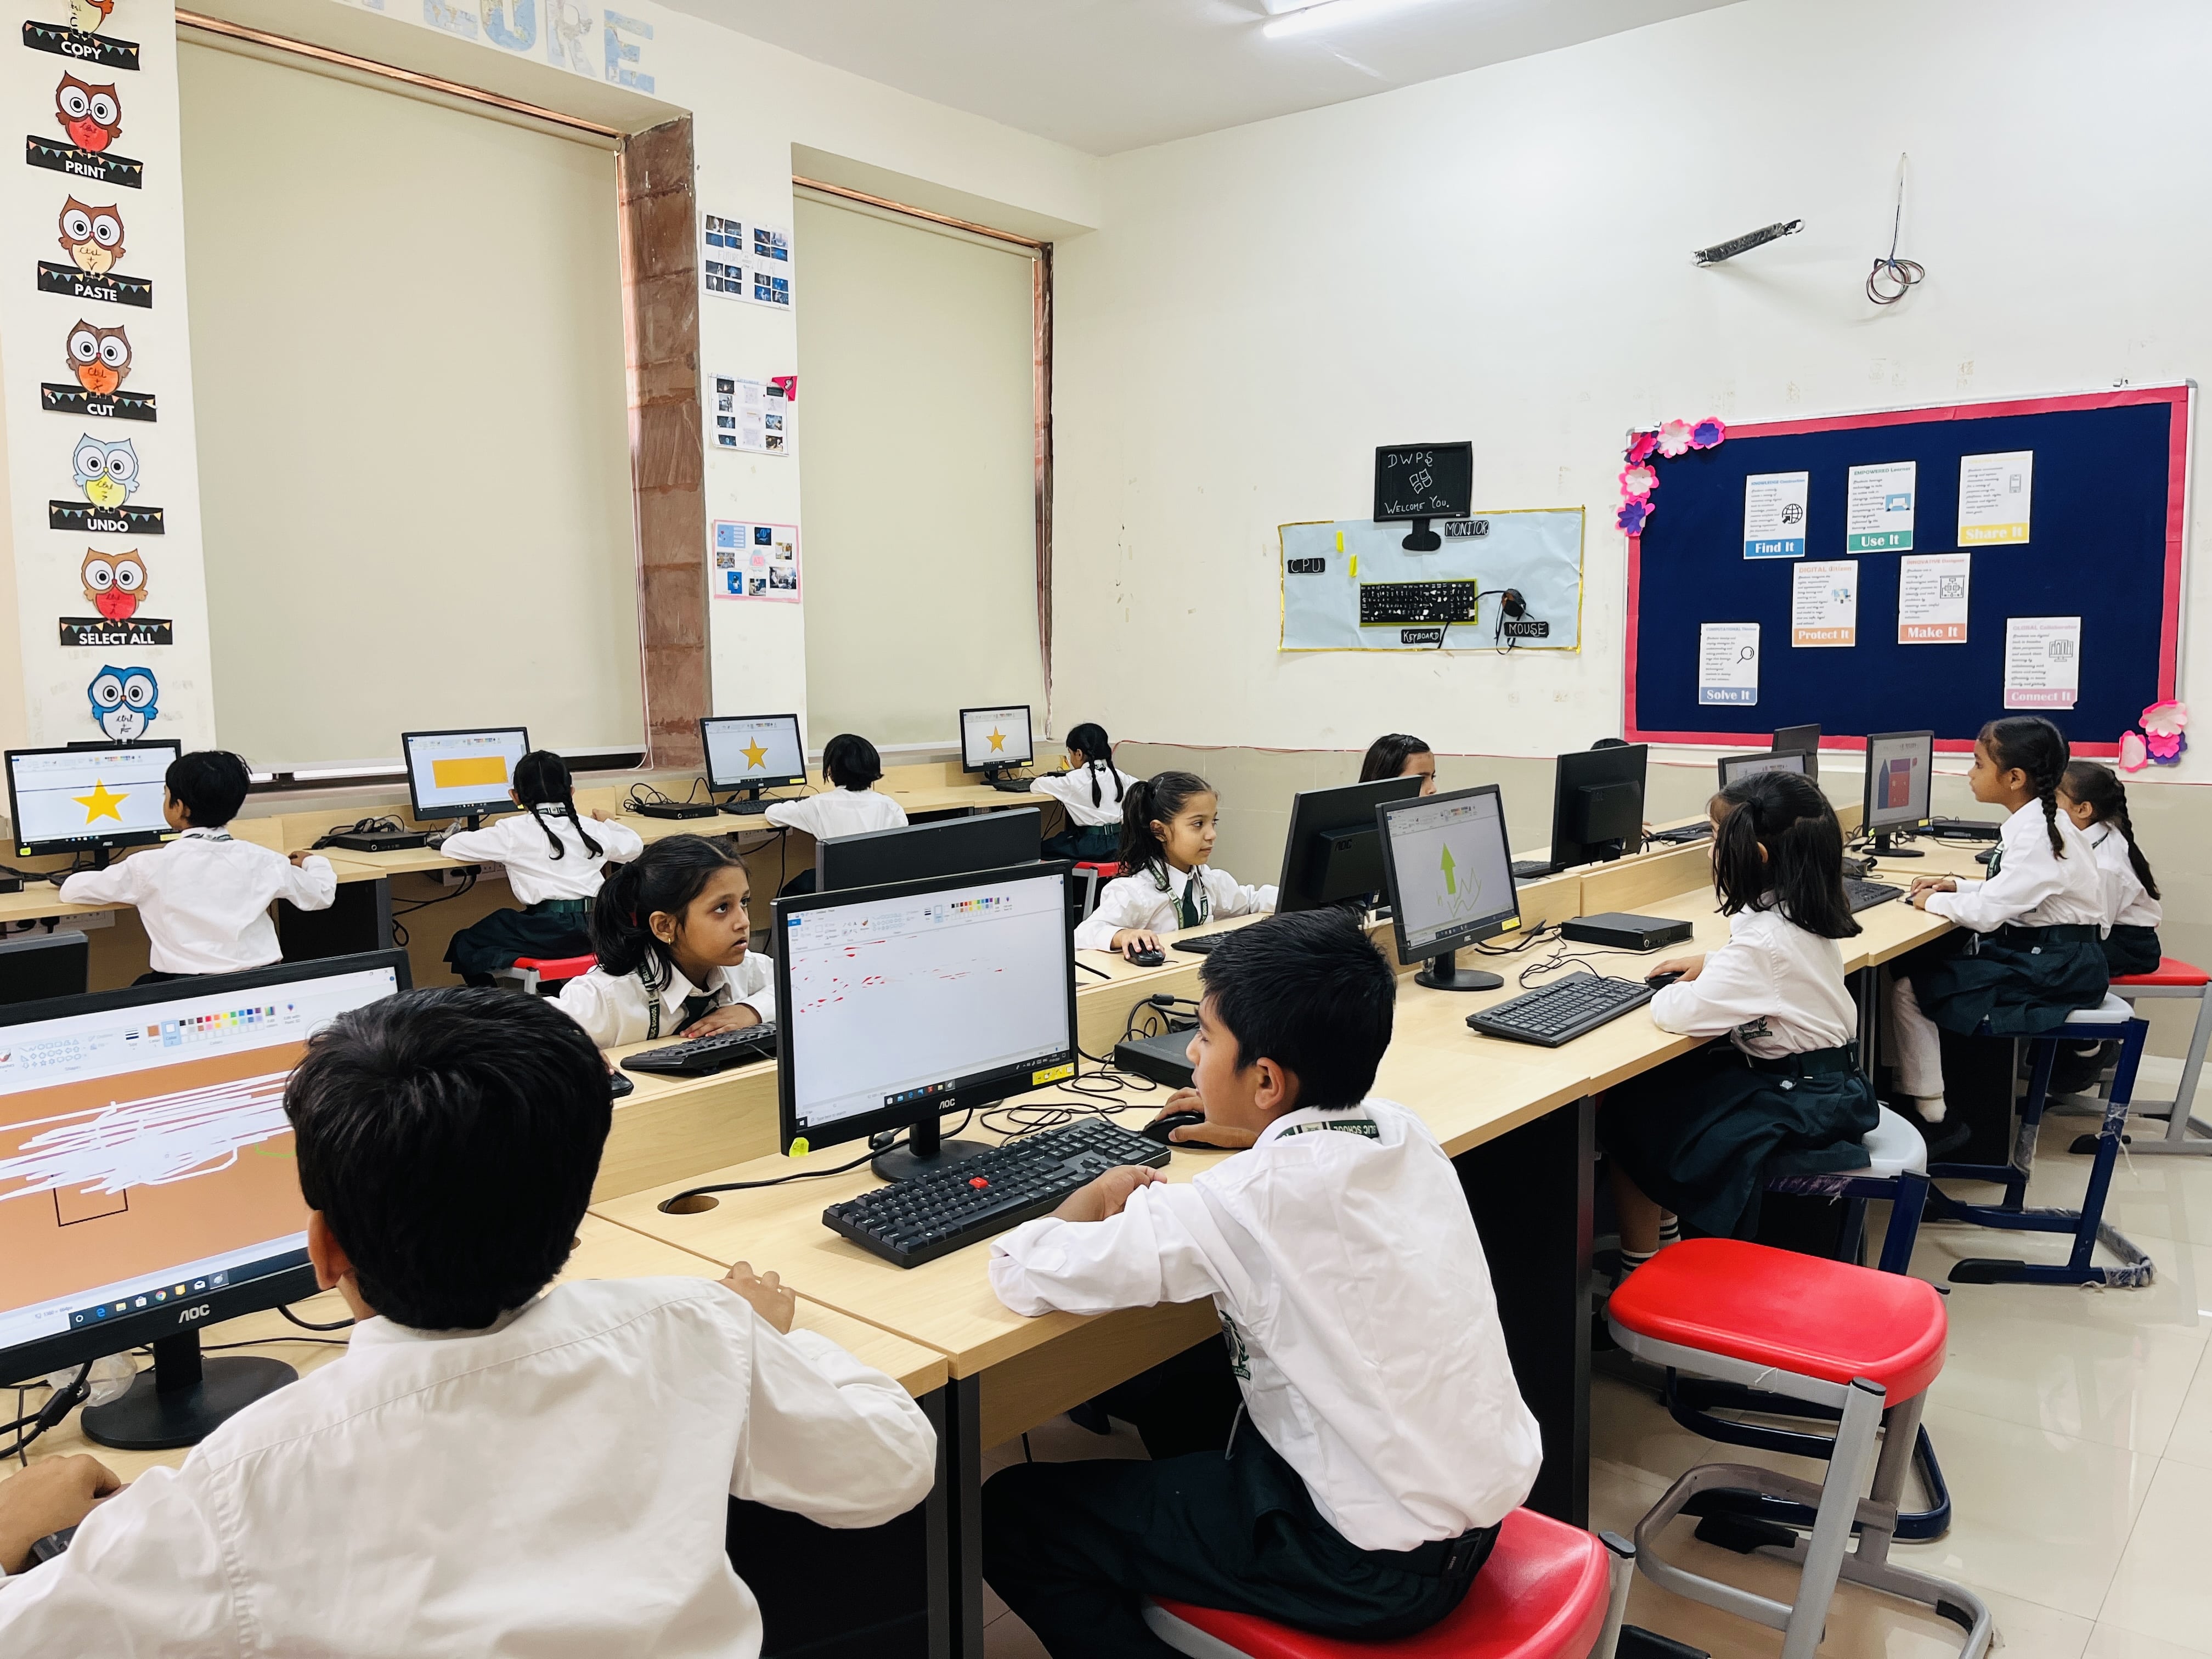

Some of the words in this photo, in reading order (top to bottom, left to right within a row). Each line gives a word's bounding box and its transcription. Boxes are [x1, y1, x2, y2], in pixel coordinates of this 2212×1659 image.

[61, 41, 102, 60] COPY
[65, 160, 106, 179] PRINT
[75, 283, 117, 301] PASTE
[87, 403, 115, 416] CUT
[1387, 451, 1434, 469] DWPS
[87, 518, 129, 532] UNDO
[1446, 521, 1489, 537] MONITOR
[1966, 527, 2007, 540] Share
[2012, 526, 2022, 538] It
[1755, 541, 1781, 554] Find
[1785, 541, 1795, 552] It
[1861, 535, 1885, 547] Use
[1889, 534, 1899, 545] It
[1289, 558, 1321, 573] CPU
[1509, 623, 1546, 637] MOUSE
[1798, 630, 1837, 640] Protect
[1841, 629, 1849, 639] It
[1908, 627, 1943, 638] Make
[1948, 627, 1958, 637] It
[79, 633, 127, 645] SELECT
[130, 633, 155, 644] ALL
[1403, 630, 1440, 645] KEYBOARD
[1707, 689, 1737, 700] Solve
[1741, 690, 1750, 700] It
[2011, 691, 2058, 701] Connect
[2062, 691, 2072, 701] It
[939, 1098, 956, 1110] AOC
[178, 1304, 210, 1324] AOC
